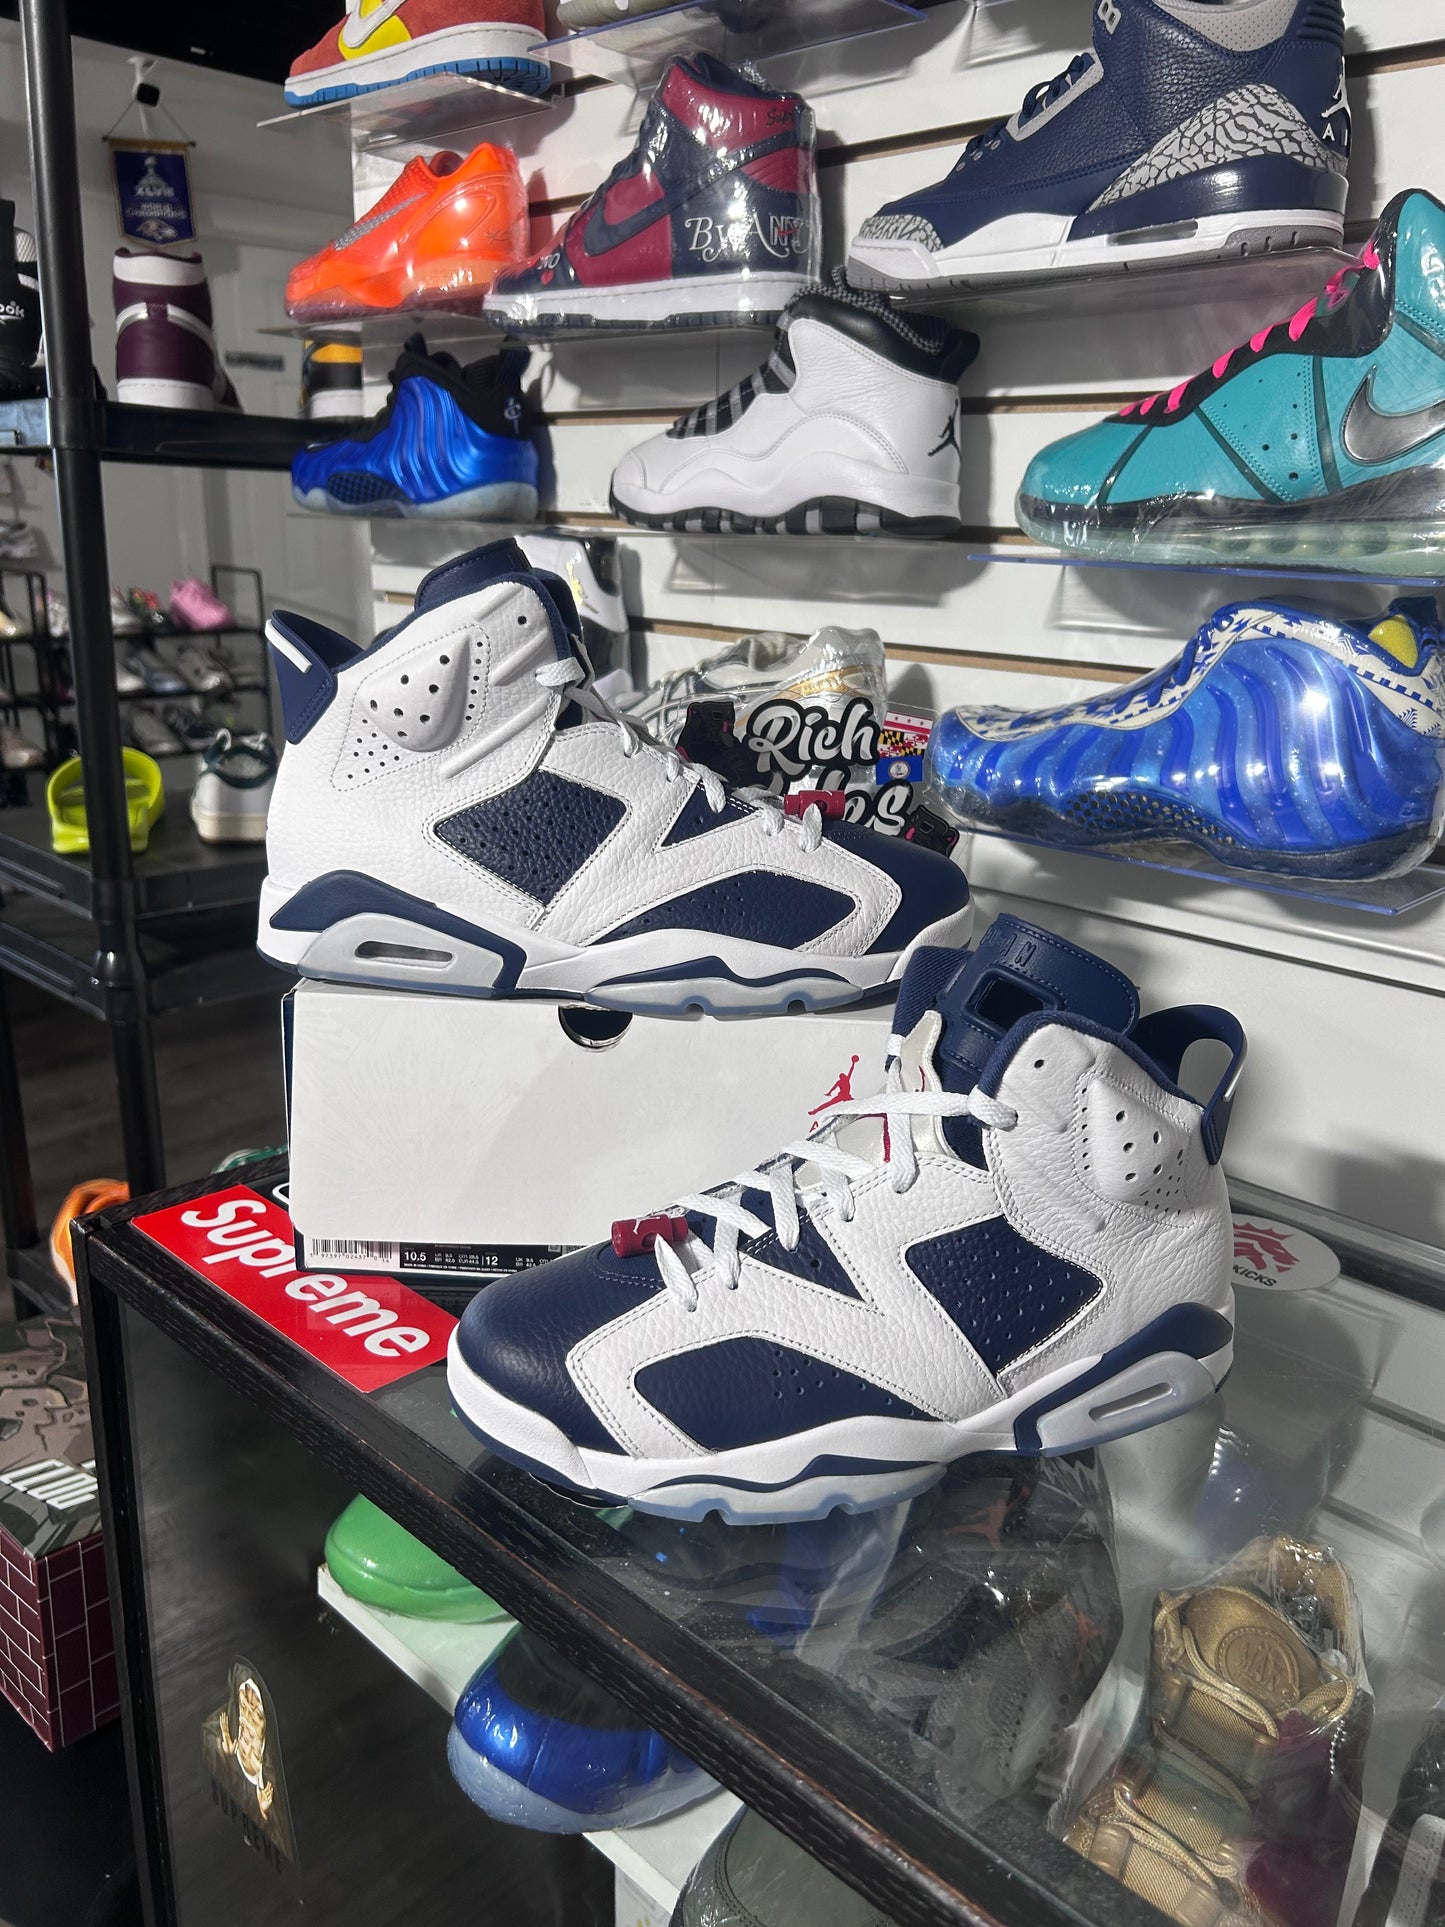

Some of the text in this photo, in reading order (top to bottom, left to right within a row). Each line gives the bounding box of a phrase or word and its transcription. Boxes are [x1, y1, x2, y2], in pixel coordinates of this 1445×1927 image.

[748, 702, 874, 776] Rich
[180, 1199, 431, 1357] Supreme
[404, 1251, 427, 1262] 10.5
[485, 1255, 499, 1267] 12
[1232, 1264, 1278, 1287] KICKS
